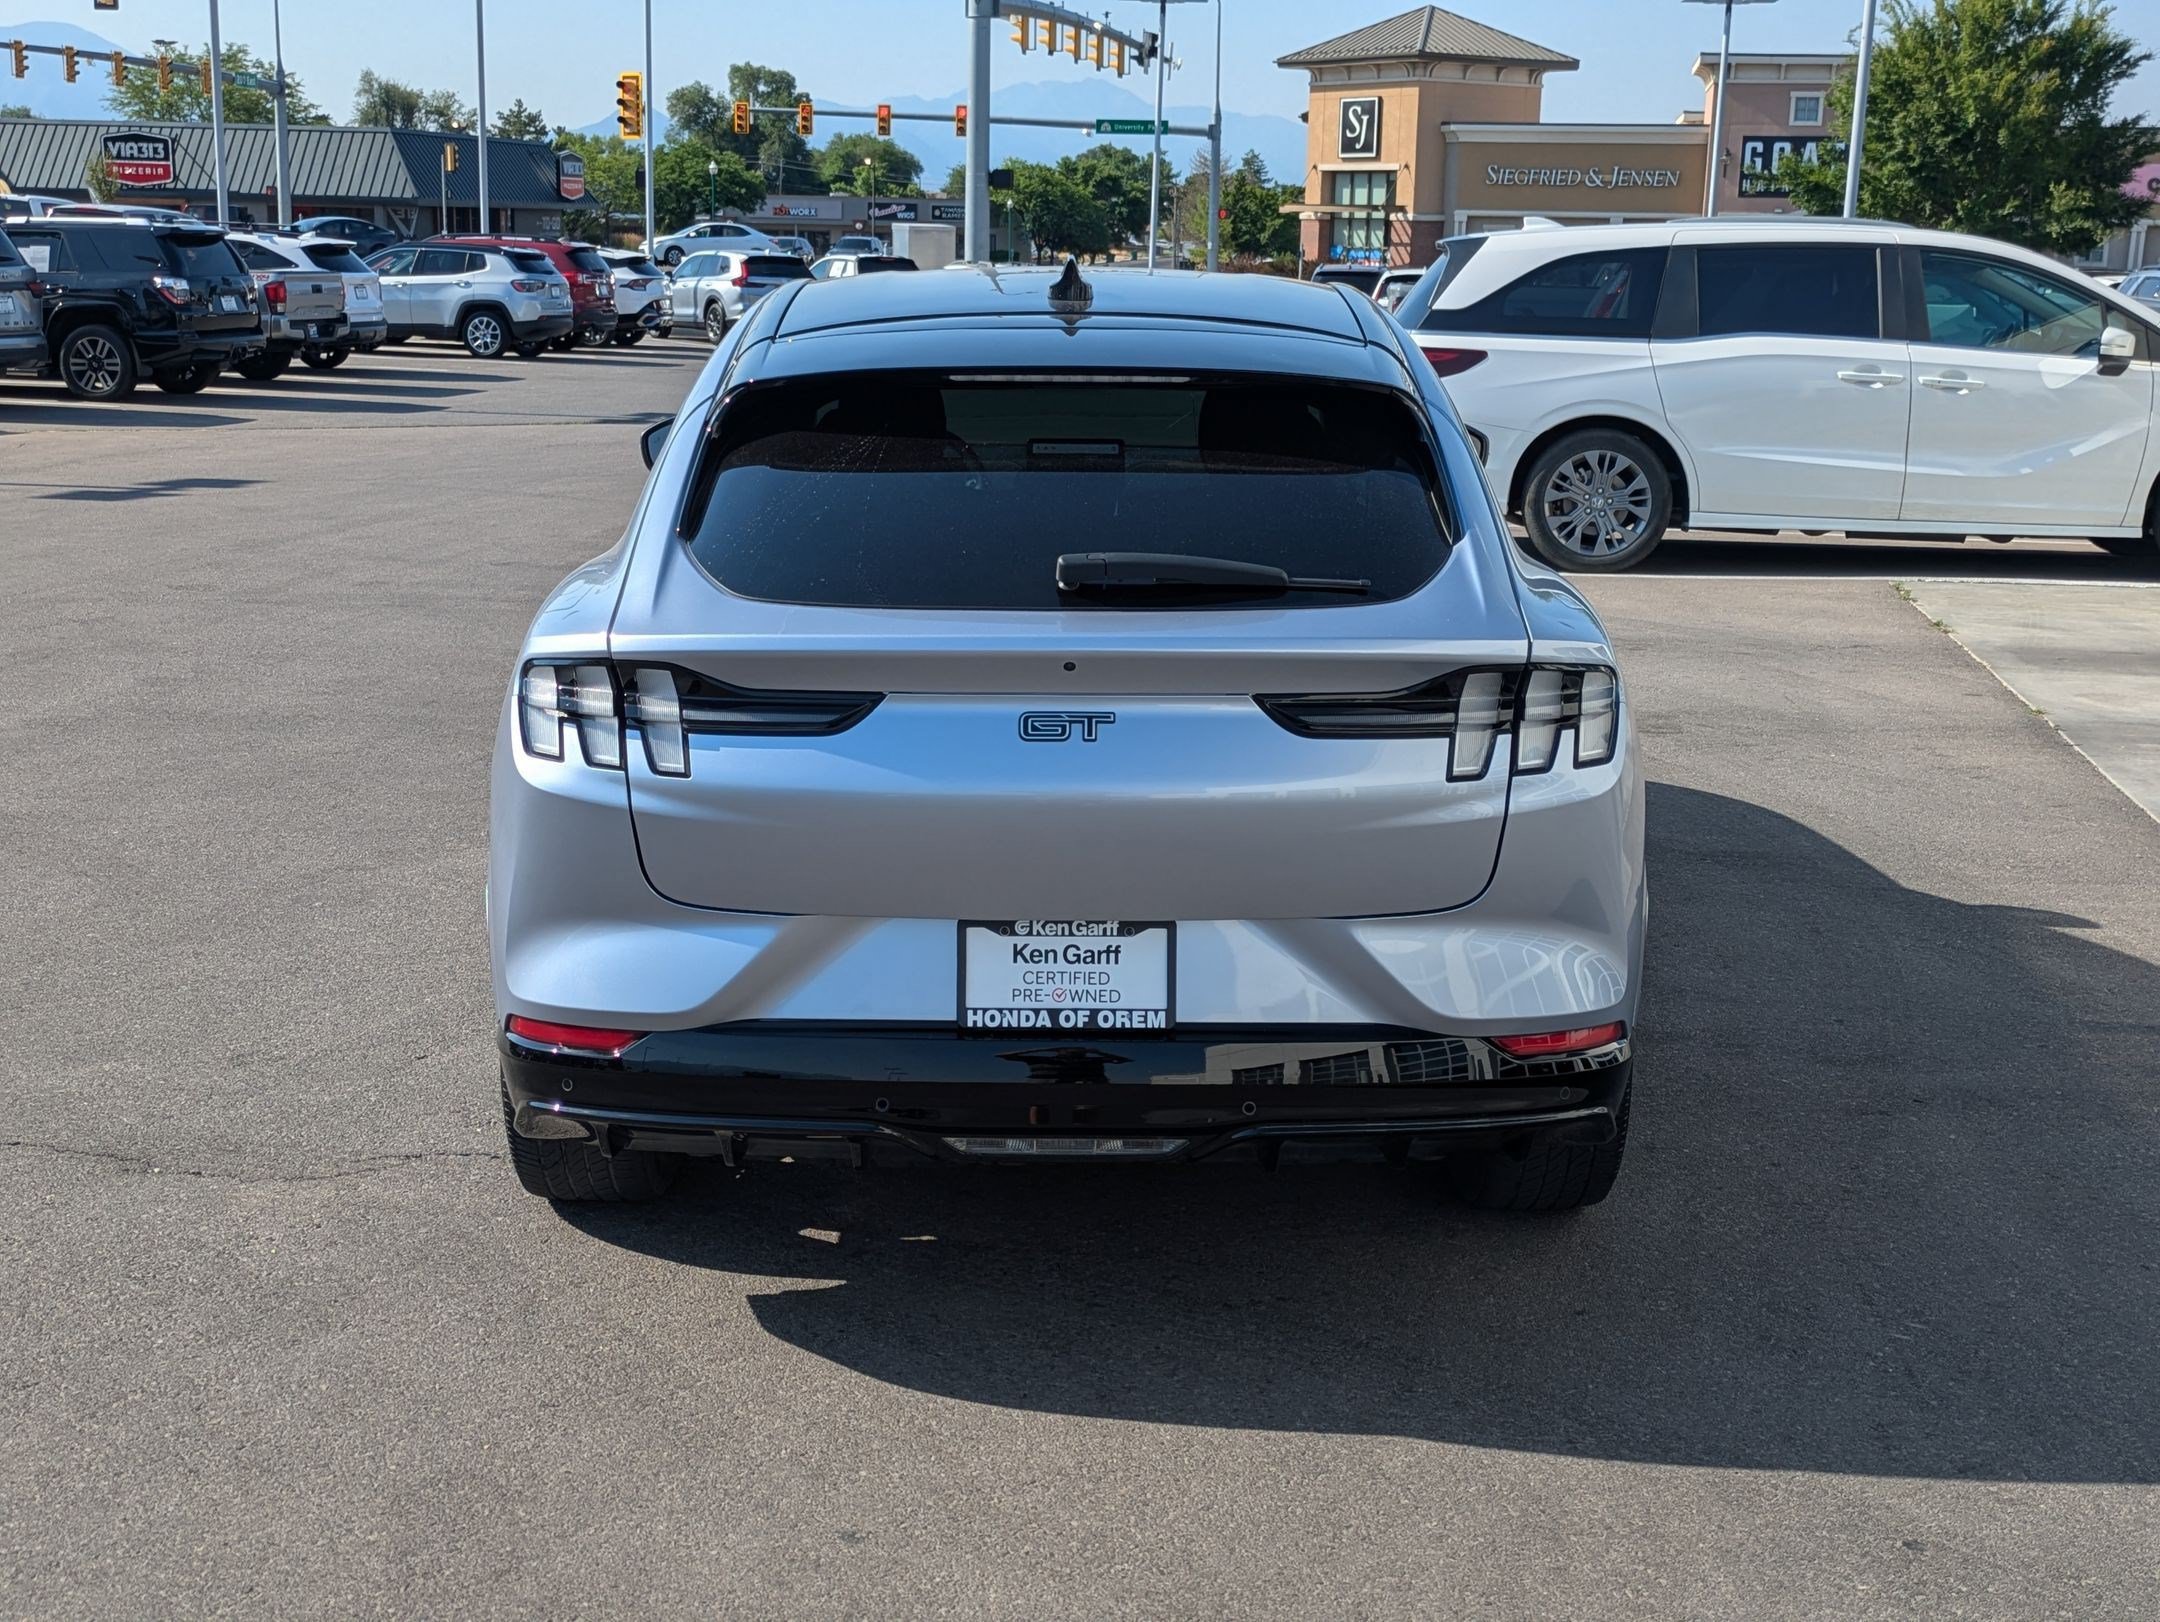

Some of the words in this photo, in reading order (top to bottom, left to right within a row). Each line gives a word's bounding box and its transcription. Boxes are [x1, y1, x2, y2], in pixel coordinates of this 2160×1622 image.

[1113, 123, 1145, 132] University
[1345, 104, 1370, 150] SJ
[1743, 141, 1846, 175] GOA
[112, 165, 164, 175] PIZZERIA
[1584, 167, 1605, 187] &
[896, 211, 916, 220] WIGS
[1018, 711, 1116, 742] GT
[1032, 920, 1070, 936] Ken
[1072, 920, 1120, 936] Garff
[1012, 943, 1058, 964] Ken
[1062, 944, 1121, 965] Garff
[1022, 970, 1110, 986] CERTIFIED
[967, 1009, 1052, 1028] HONDA
[1058, 1010, 1091, 1028] OF
[1097, 1010, 1166, 1029] OREM
